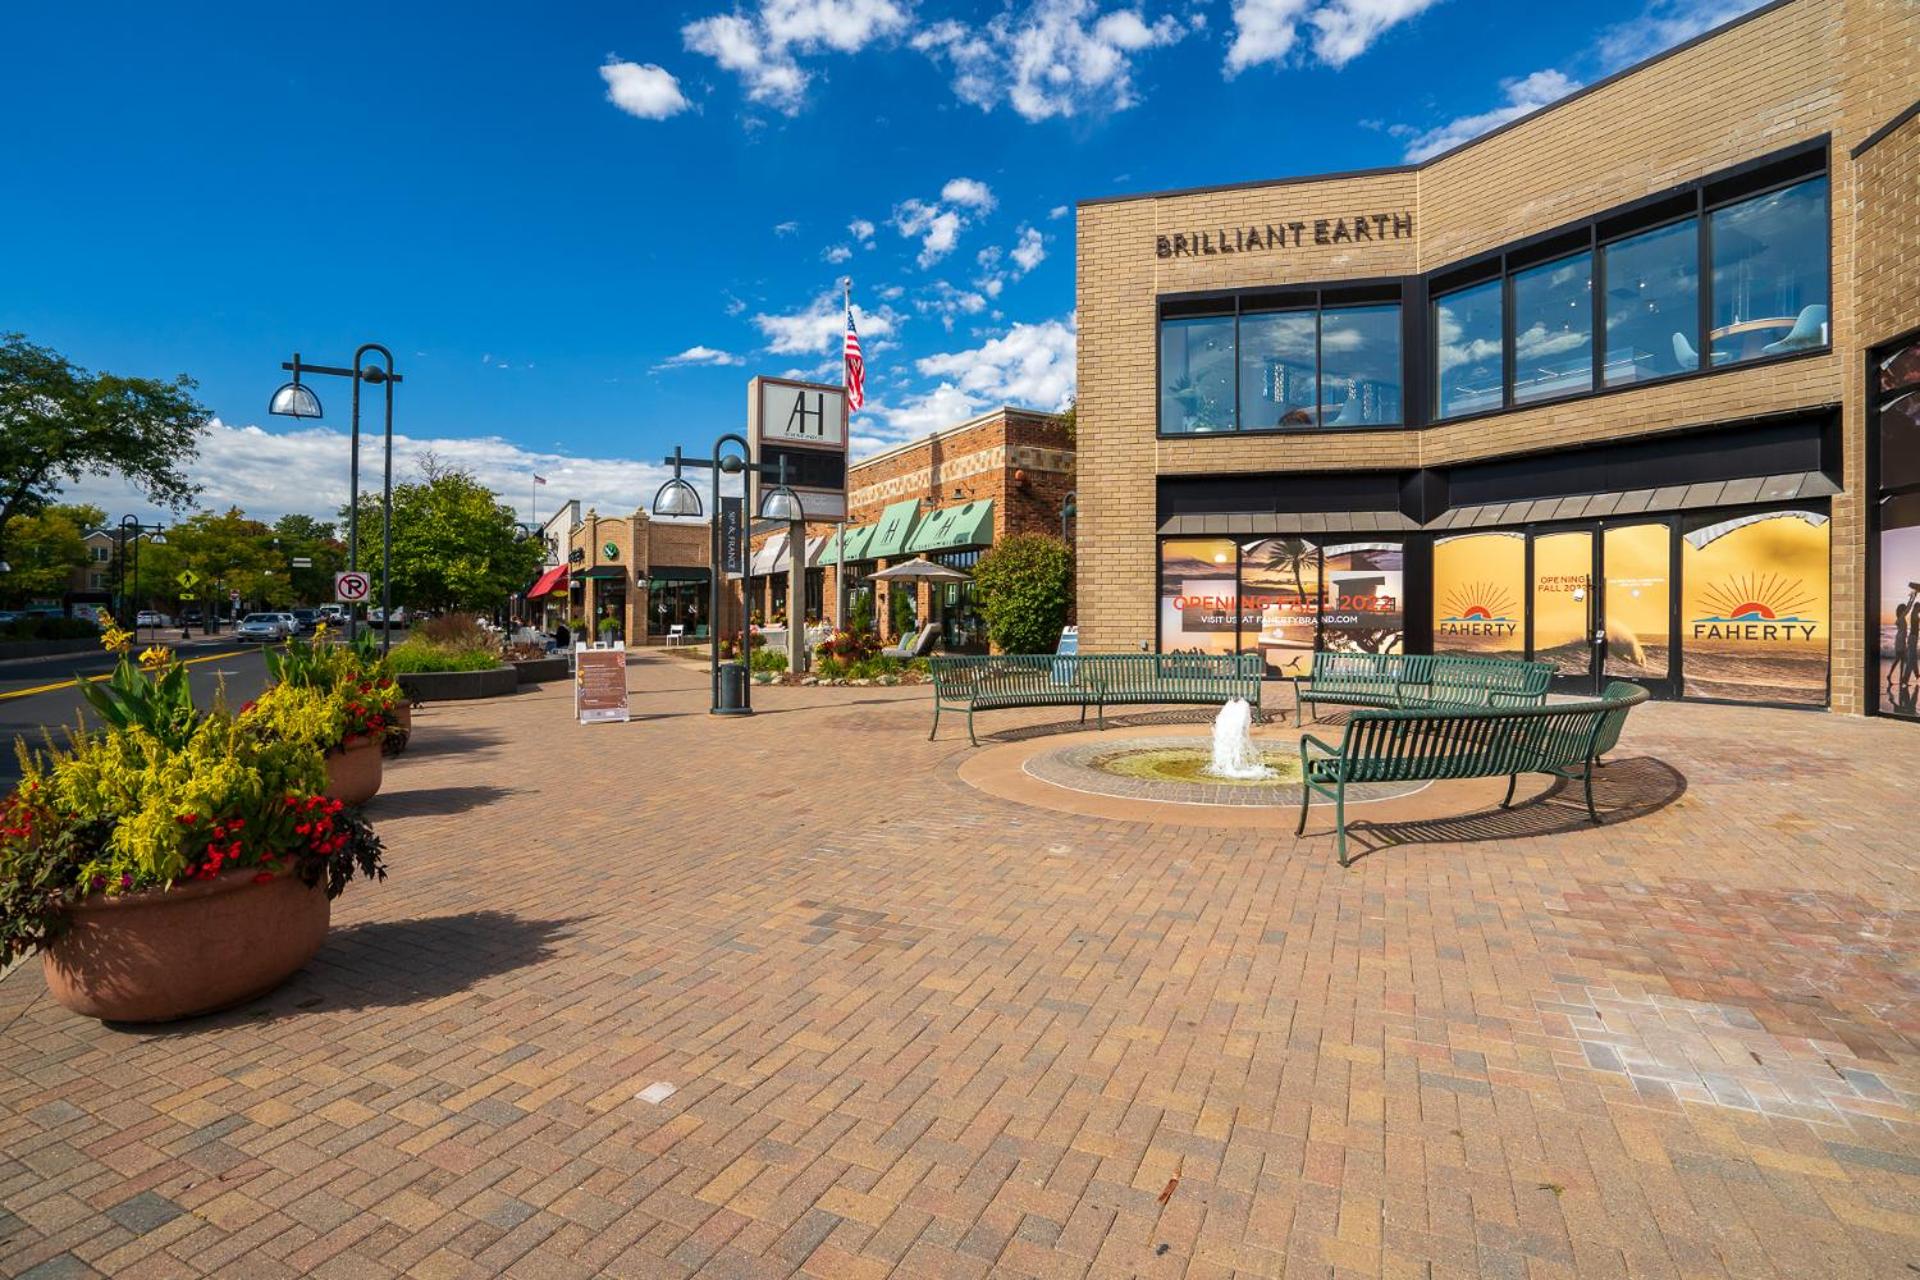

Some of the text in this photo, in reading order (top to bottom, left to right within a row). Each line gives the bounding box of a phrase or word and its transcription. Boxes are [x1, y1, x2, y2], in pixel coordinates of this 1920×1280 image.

[1156, 211, 1413, 258] BRILLIANT EARTH
[786, 391, 823, 436] AH
[1541, 576, 1585, 584] OPENING
[1173, 594, 1392, 612] OPENING FALL 2022
[1201, 616, 1223, 624] VISIT
[1226, 616, 1237, 624] US
[1242, 616, 1255, 624] AT
[1440, 623, 1516, 636] FAHERTY
[1694, 625, 1816, 641] FAHERTY
